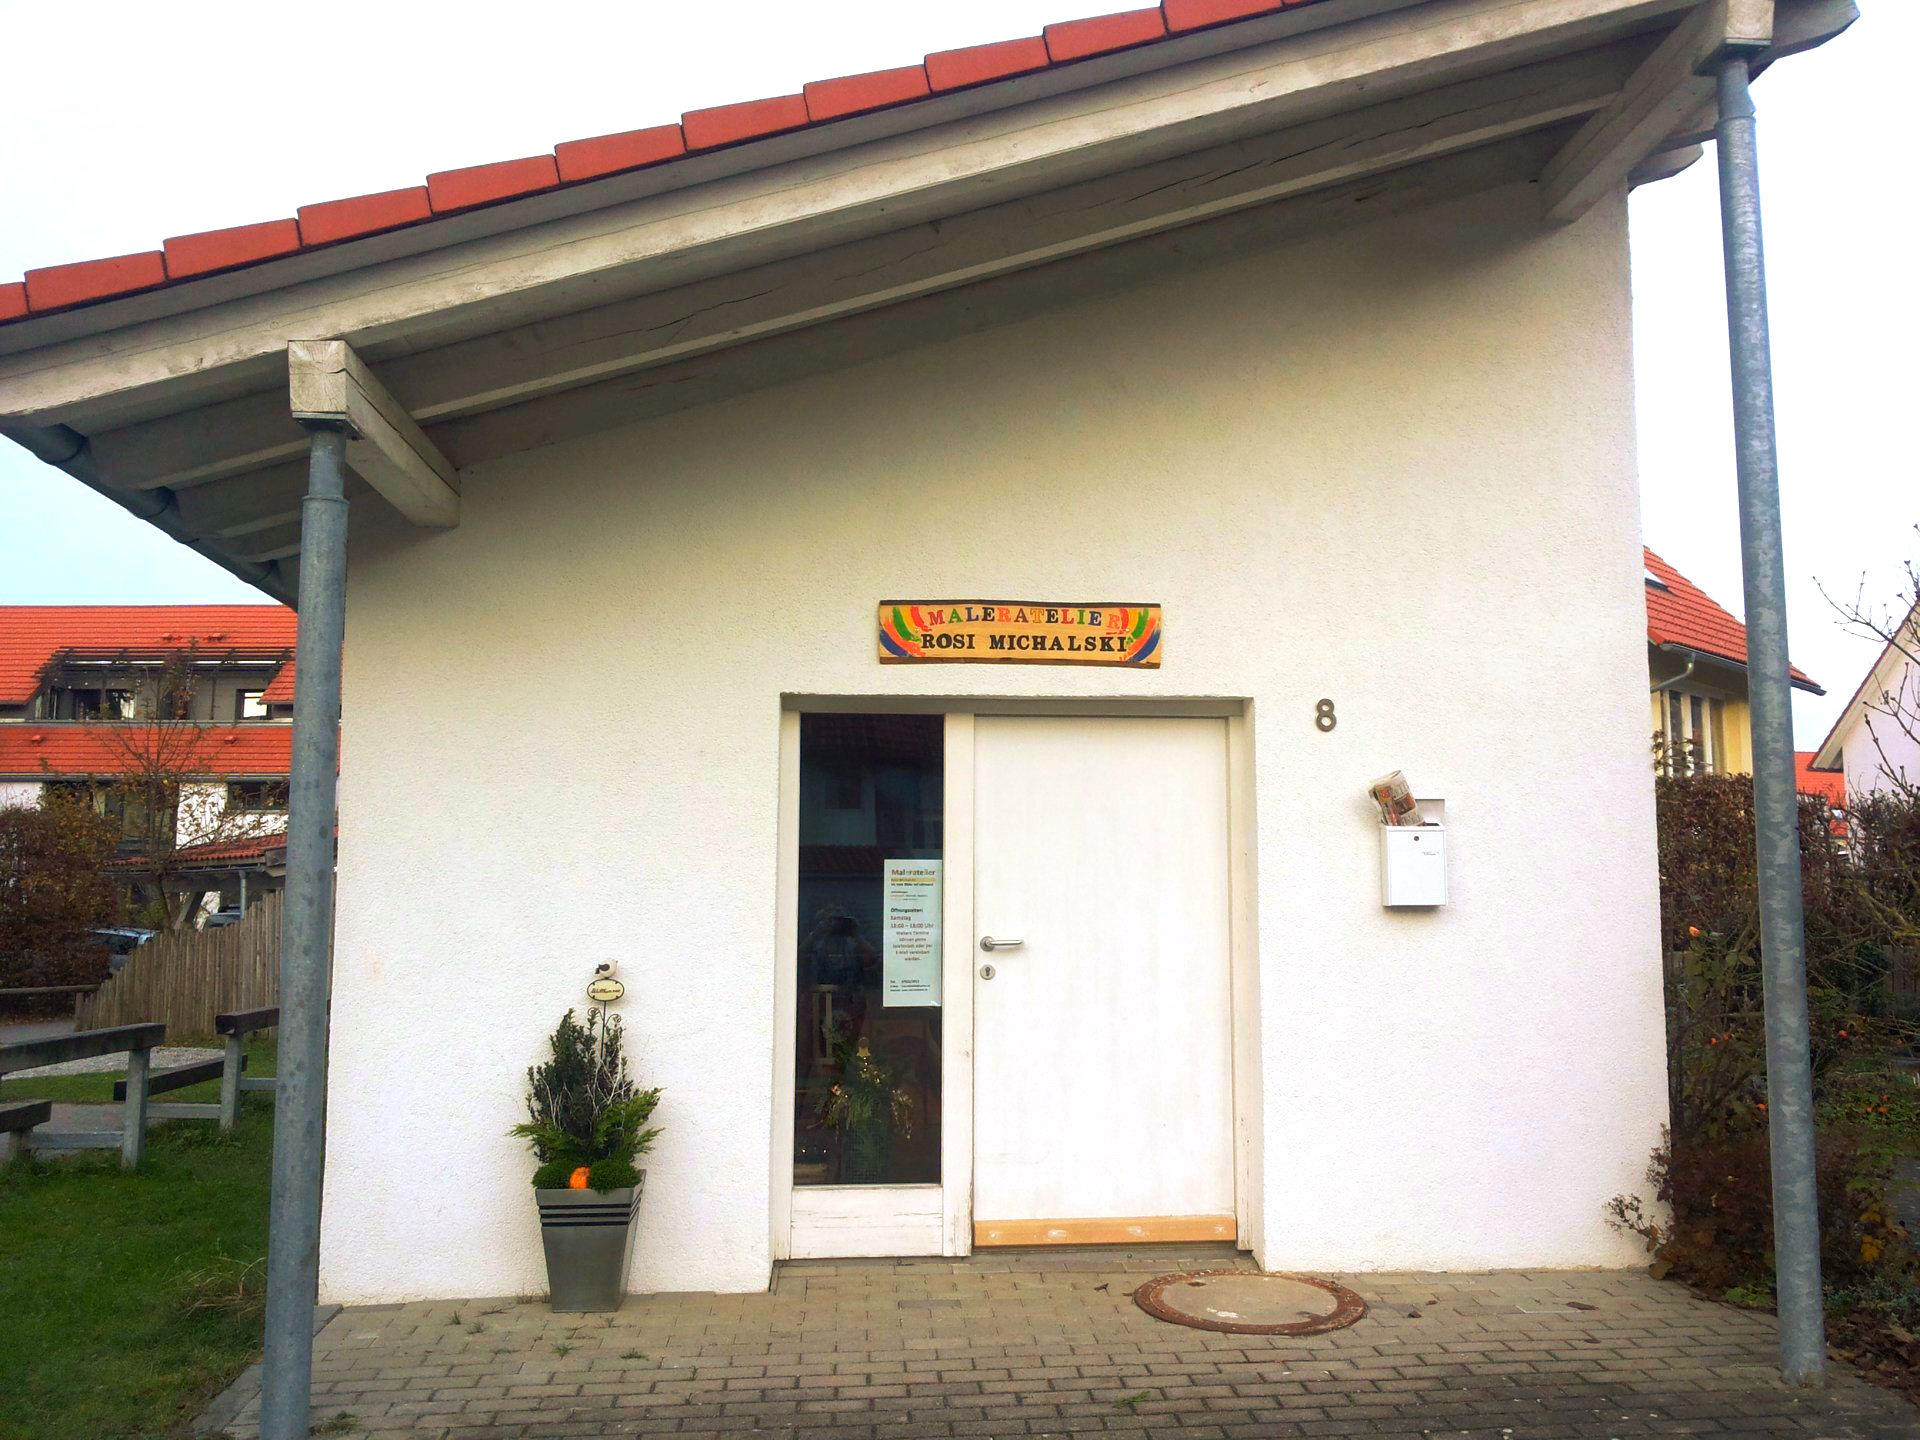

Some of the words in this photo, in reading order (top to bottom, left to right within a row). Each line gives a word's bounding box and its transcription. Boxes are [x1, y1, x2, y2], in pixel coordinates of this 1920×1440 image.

[928, 606, 1122, 630] MALERATELIER
[920, 633, 975, 650] ROSI
[989, 634, 1127, 652] MICHALSKI
[1316, 698, 1337, 732] 8
